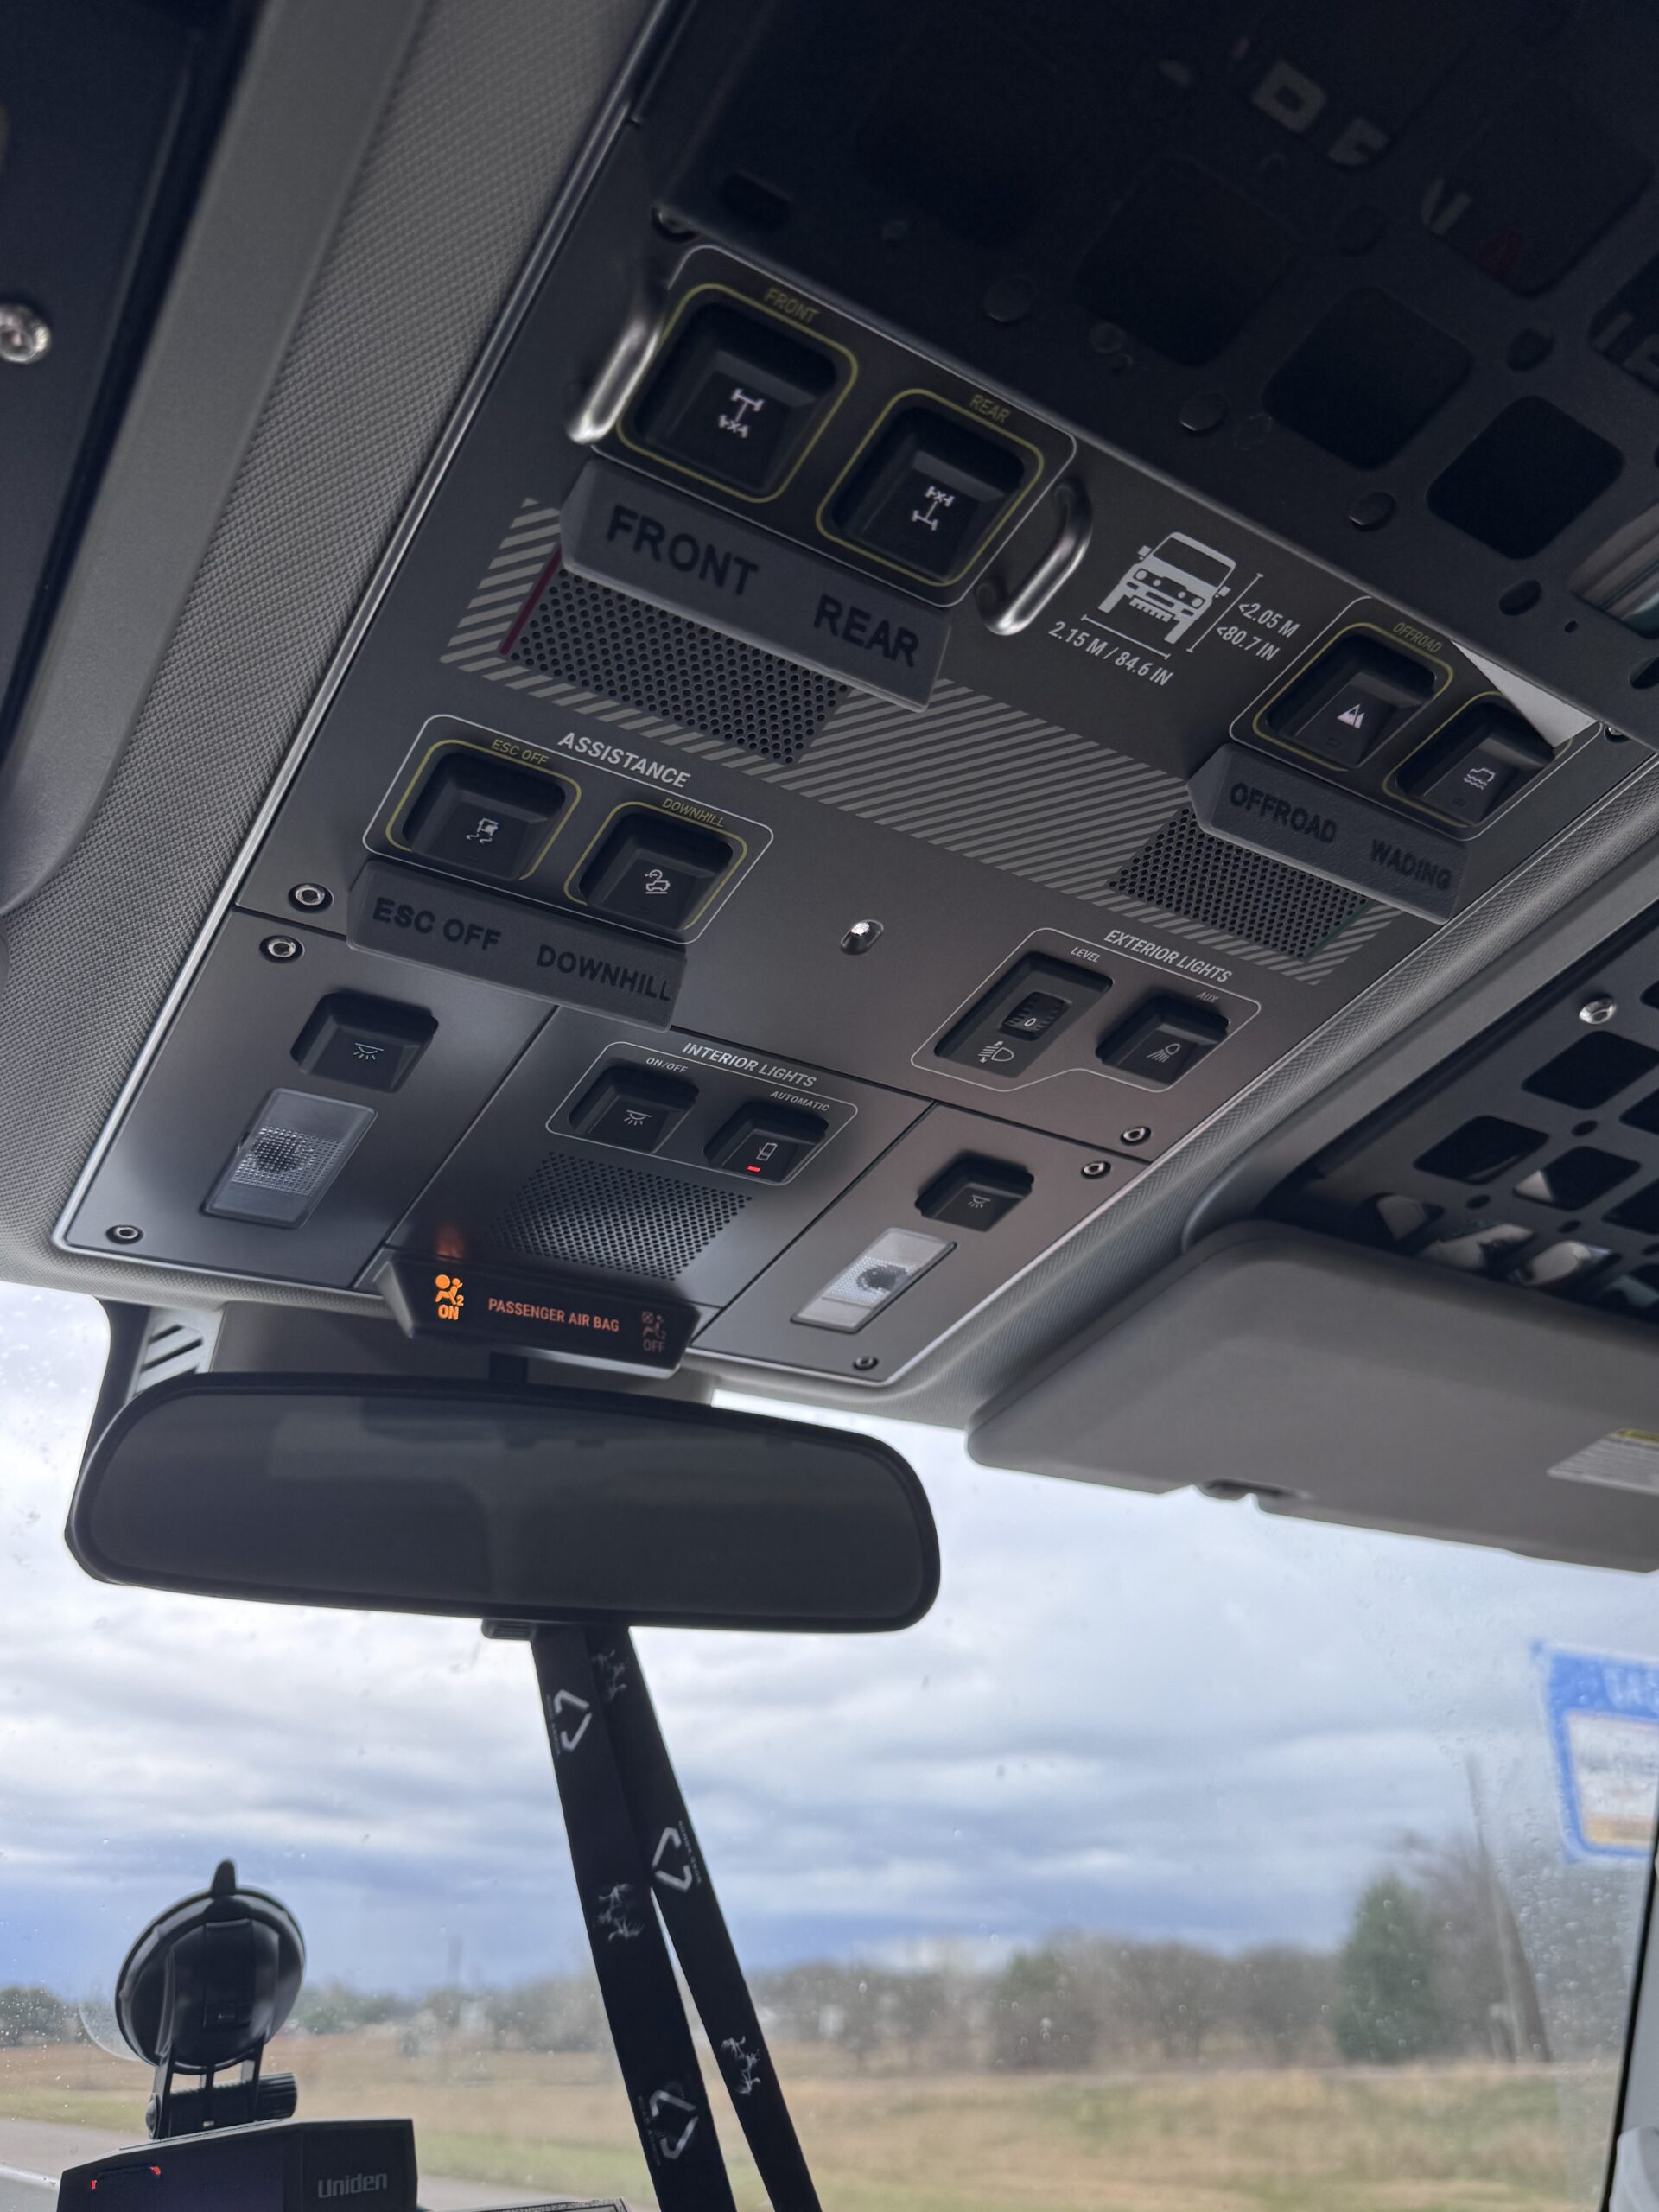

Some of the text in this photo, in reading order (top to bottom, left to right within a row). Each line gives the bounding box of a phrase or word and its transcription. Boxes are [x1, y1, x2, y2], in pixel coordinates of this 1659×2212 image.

[764, 287, 821, 325] FRONT
[969, 393, 1010, 424] REAR
[605, 505, 760, 596] FRONT
[813, 594, 920, 668] REAR
[1238, 602, 1300, 639] <2.05 M
[1393, 622, 1443, 653] OFFROAD
[1048, 621, 1174, 686] 2.15 M / 84.6 IN
[1217, 626, 1281, 661] <80.7 IN
[491, 739, 550, 766] ESC OFF
[557, 732, 691, 788] ASSISTANCE
[662, 798, 725, 829] DOWNHILL
[1229, 780, 1338, 844] OFFROAD
[1369, 837, 1452, 891] WADING
[372, 896, 502, 950] ESC OFF
[1071, 946, 1101, 963] LEVEL
[1103, 929, 1232, 982] EXTERIOR LIGHTS
[536, 944, 671, 1002] DOWNHILL
[1196, 991, 1219, 1003] AUX
[645, 1057, 689, 1074] ON/OFF
[682, 1042, 817, 1089] INTERIOR LIGHTS
[769, 1090, 830, 1113] AUTOMATIC
[437, 1304, 459, 1320] ON
[488, 1298, 620, 1332] PASSENGER AIR BAG
[643, 1339, 665, 1353] OFF
[318, 2173, 388, 2198] Uniden
